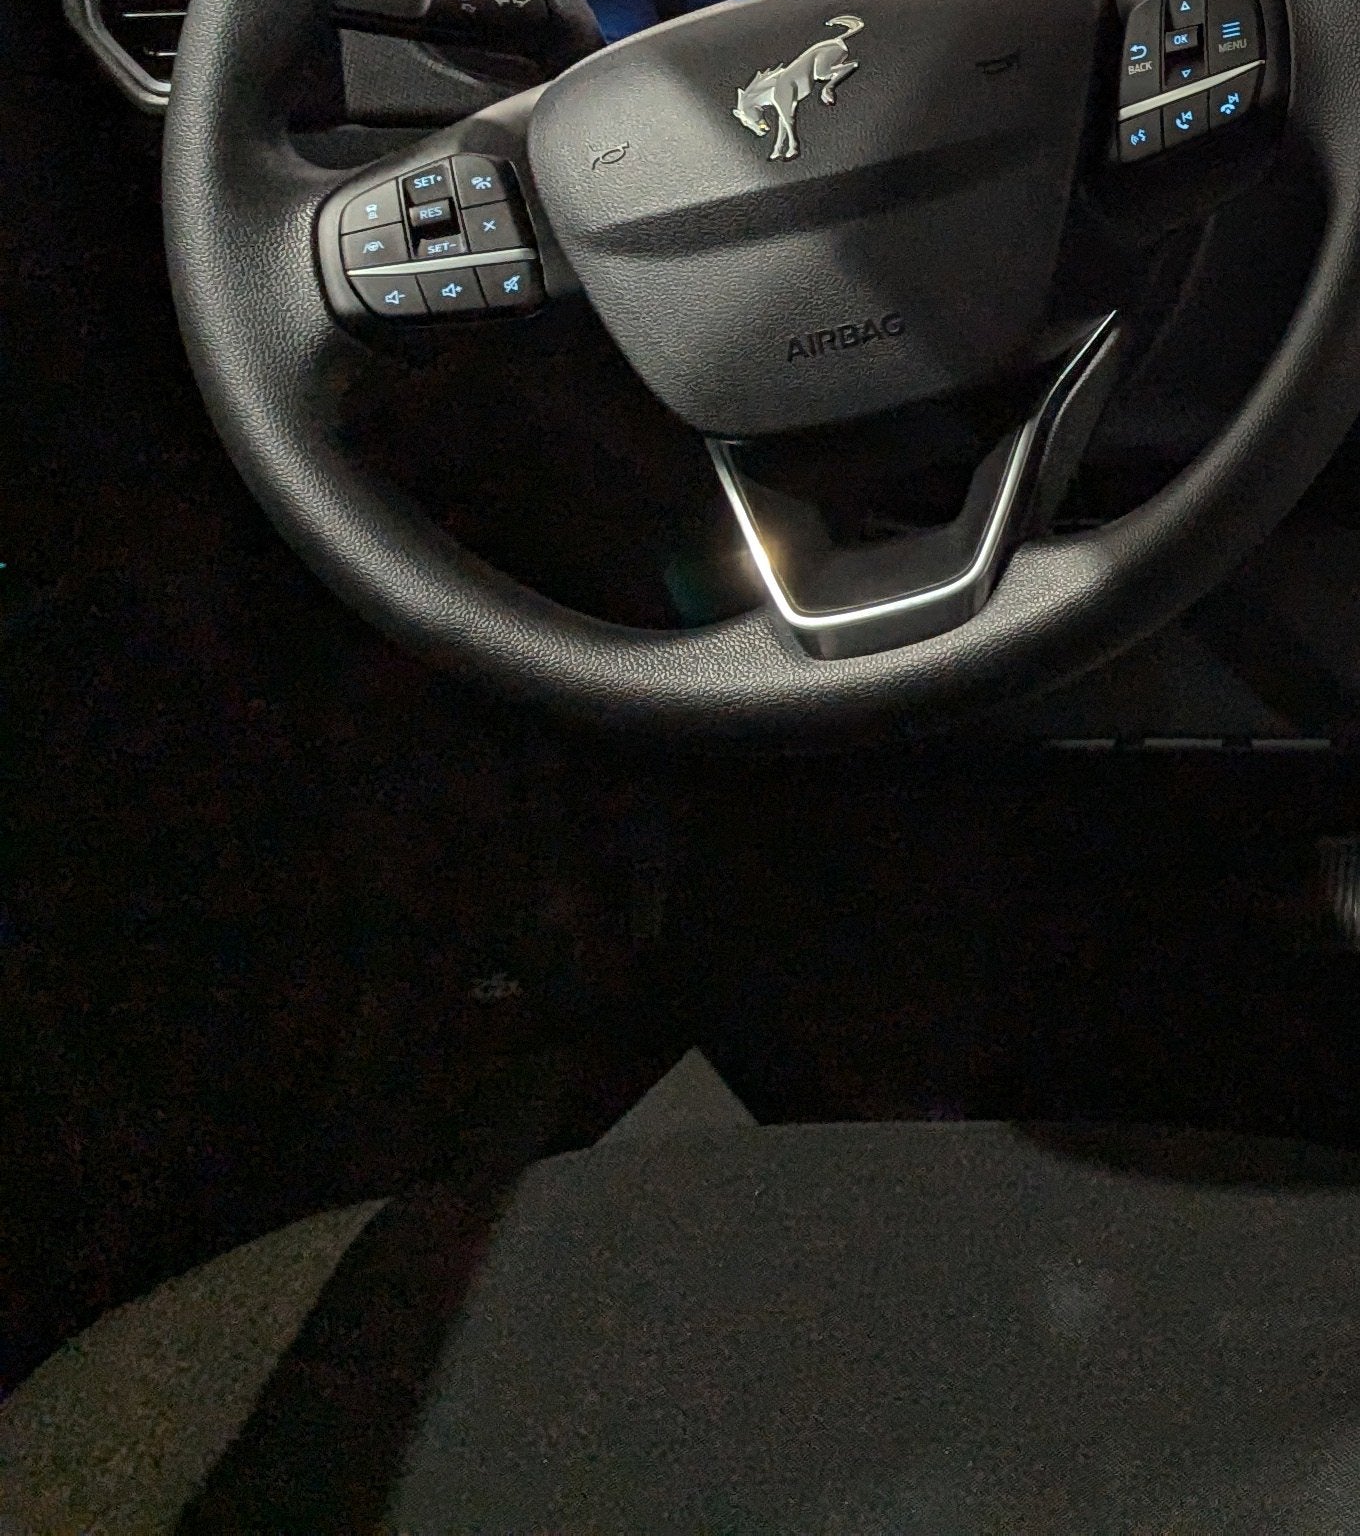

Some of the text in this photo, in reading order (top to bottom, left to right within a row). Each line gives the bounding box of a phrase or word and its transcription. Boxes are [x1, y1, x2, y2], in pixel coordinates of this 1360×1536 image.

[1173, 33, 1189, 45] OK
[1218, 38, 1247, 53] MENU
[1128, 61, 1153, 75] BACK
[419, 206, 443, 220] RES
[786, 312, 905, 363] AIRBAG
